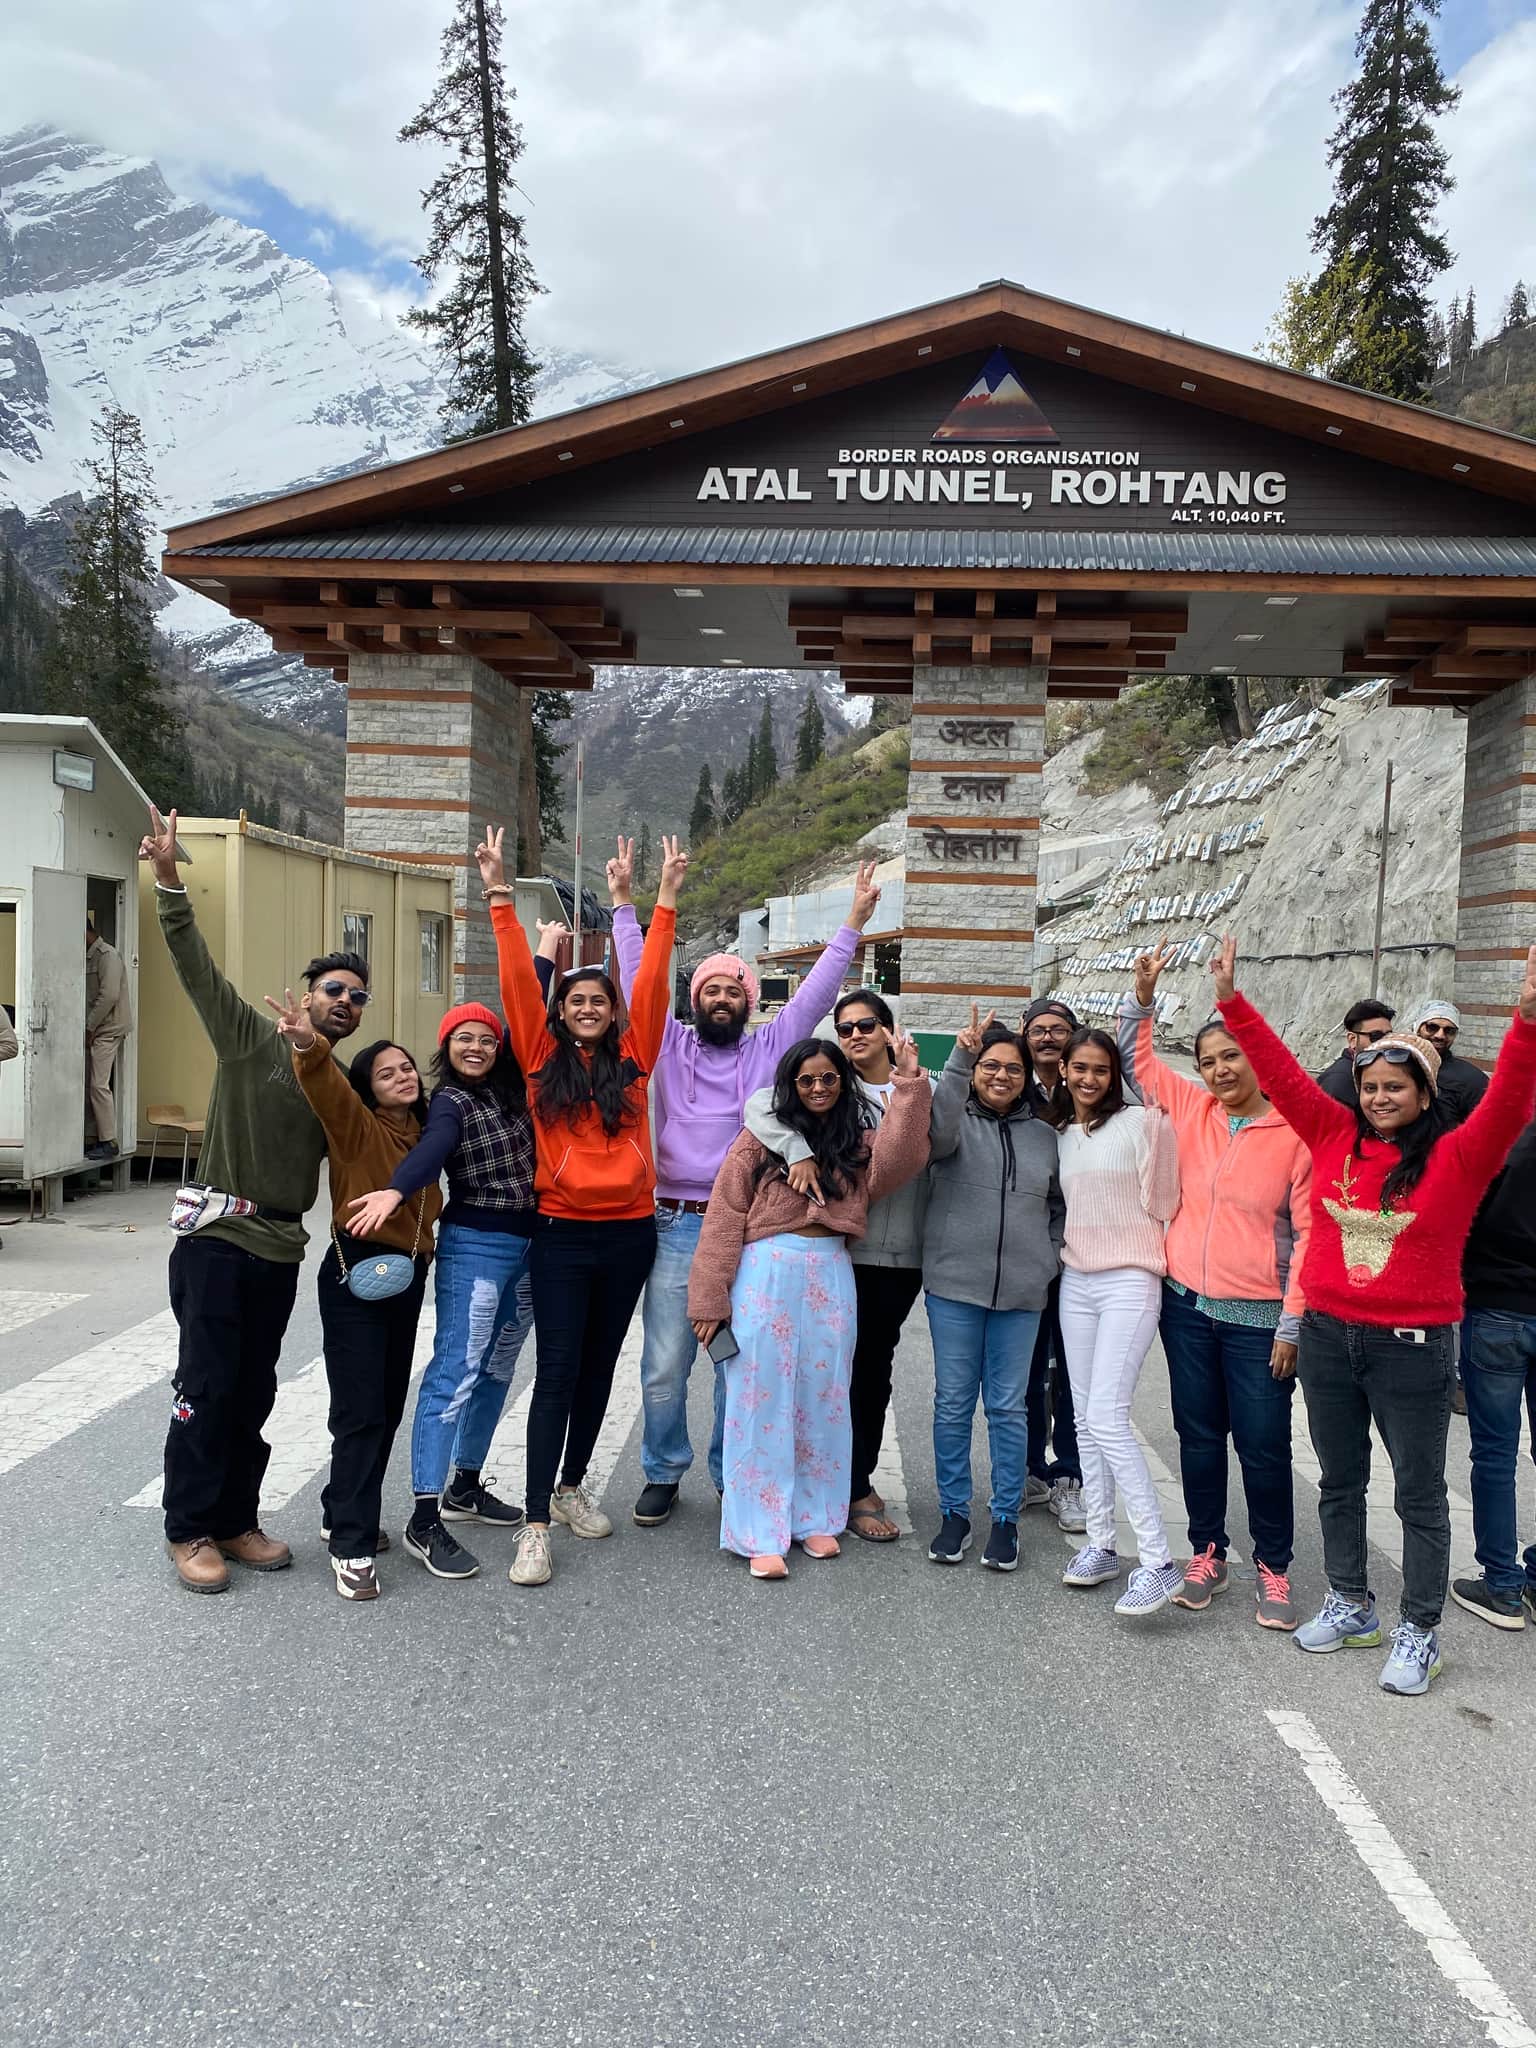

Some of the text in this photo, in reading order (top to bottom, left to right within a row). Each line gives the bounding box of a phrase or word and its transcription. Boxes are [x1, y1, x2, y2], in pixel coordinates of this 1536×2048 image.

[838, 448, 1140, 466] BORDER ROADS ORGANISATION
[696, 467, 1287, 511] ATAL TUNNEL, ROHTANG
[1171, 509, 1287, 525] ALT. 10,040 FT.
[938, 720, 1015, 747] अटल
[941, 776, 1011, 803] टनल
[922, 824, 1023, 862] रोहतांग
